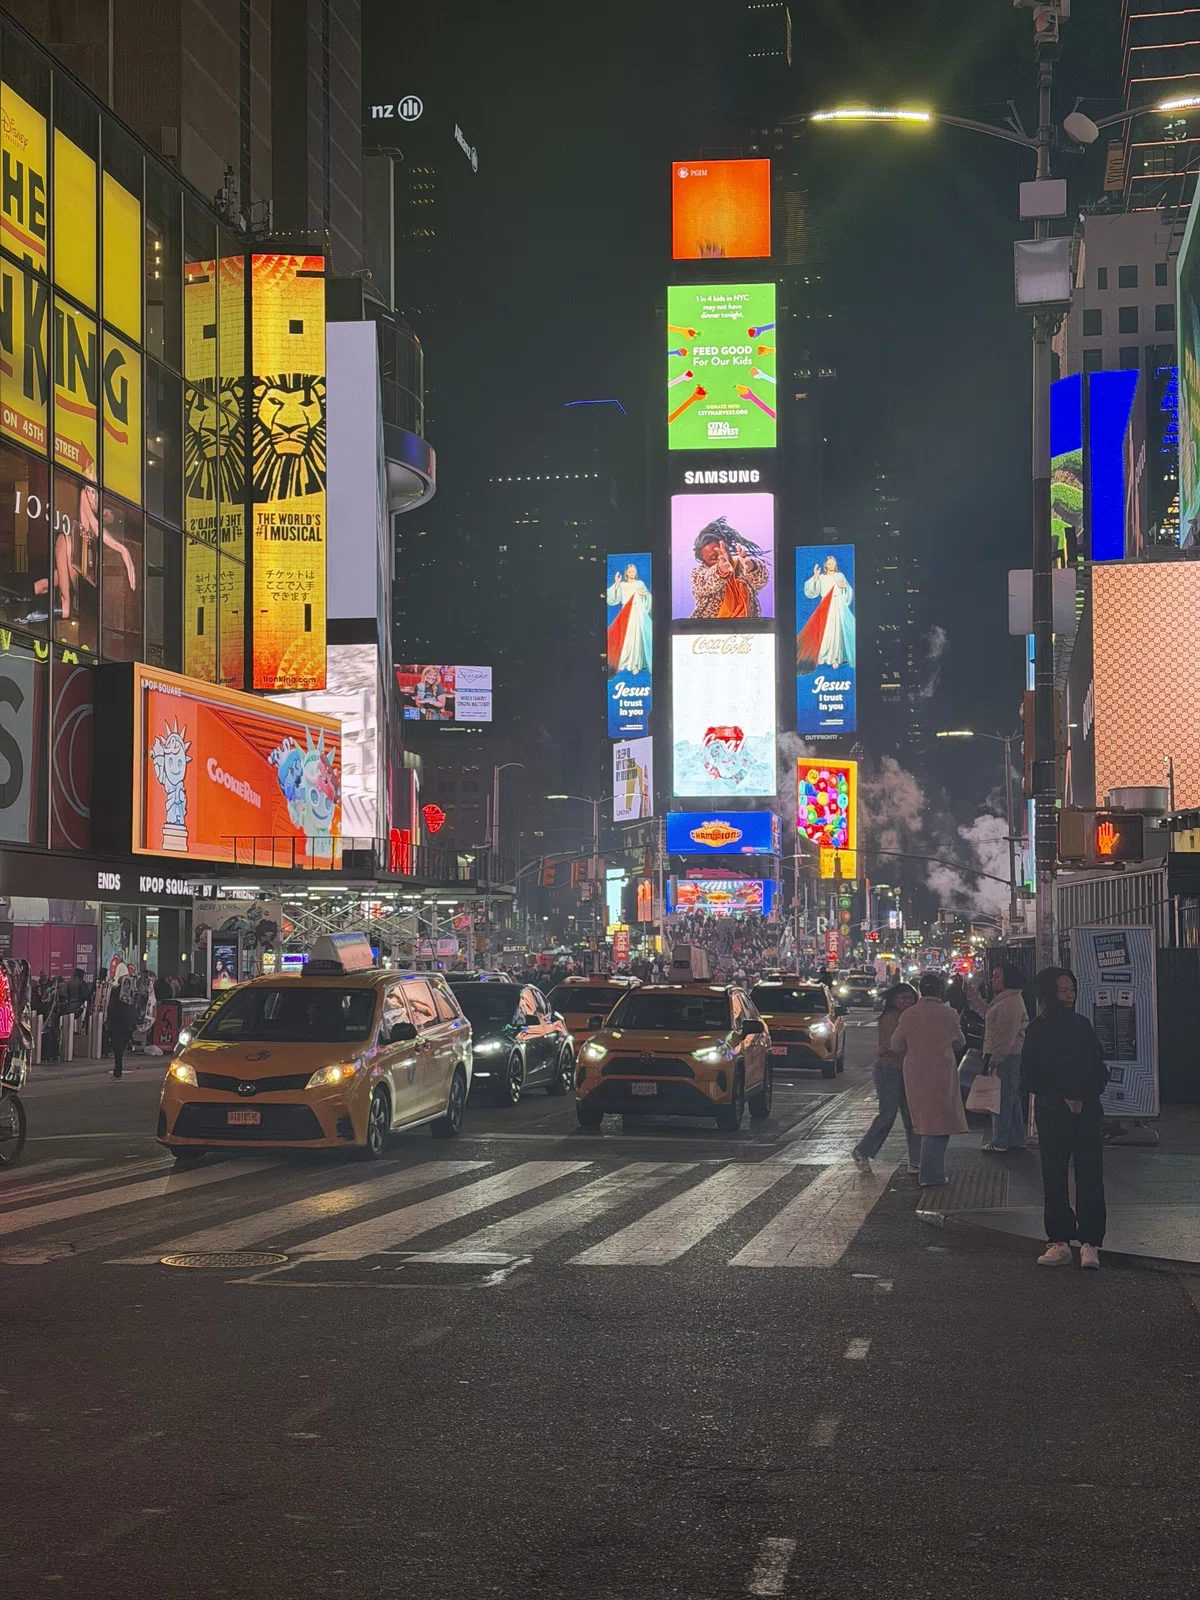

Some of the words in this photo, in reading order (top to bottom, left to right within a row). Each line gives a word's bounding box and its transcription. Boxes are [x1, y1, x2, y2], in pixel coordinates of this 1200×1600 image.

[690, 169, 708, 177] PGIM
[721, 312, 745, 320] tonight.
[23, 250, 129, 427] KING
[693, 347, 719, 355] FEED
[721, 346, 753, 355] GOOD
[693, 357, 708, 366] For
[711, 357, 730, 366] Our
[733, 356, 753, 365] Kids
[707, 421, 723, 429] CITY
[3, 408, 18, 429] ON
[22, 419, 44, 443] 45TH
[55, 437, 80, 462] STREET
[707, 428, 739, 436] HARVEST
[684, 469, 760, 484] SAMSUNG
[257, 513, 276, 525] THE
[279, 513, 321, 525] WORLD'S
[270, 526, 323, 542] MUSICAL
[265, 569, 315, 580] チケットは
[270, 591, 310, 601] できます
[691, 633, 755, 655] Coca-Cola
[262, 676, 317, 685] lionking.com
[811, 675, 852, 694] Jesus
[612, 681, 651, 699] Jesus
[828, 703, 844, 712] you
[628, 709, 644, 717] you
[690, 830, 742, 840] CHAMPIONS
[97, 871, 121, 891] ENDS
[139, 875, 164, 893] KPOP
[196, 903, 217, 911] NEW
[218, 903, 241, 911] YORK
[617, 932, 627, 951] tkts
[829, 931, 838, 951] tkts
[1095, 934, 1124, 945] EXPLORE
[1106, 949, 1126, 958] TIMES
[1098, 957, 1126, 967] SQUARE
